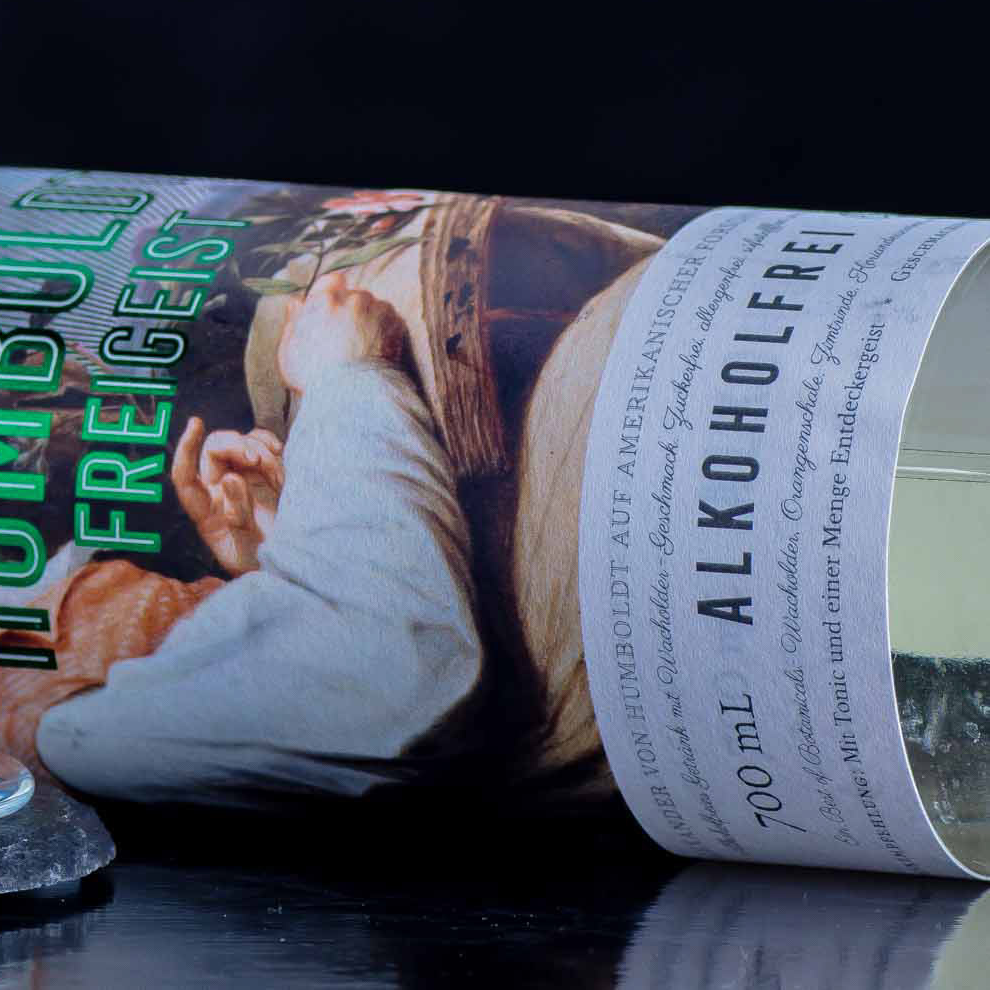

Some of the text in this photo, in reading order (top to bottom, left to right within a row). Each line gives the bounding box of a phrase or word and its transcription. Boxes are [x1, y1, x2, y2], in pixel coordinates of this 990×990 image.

[74, 209, 249, 553] FREIGEIST
[617, 253, 707, 478] AMERIKANISCHER
[830, 322, 886, 467] Entdeckergeist
[696, 230, 855, 626] ALKOHOLFREI
[611, 489, 632, 549] AUF
[822, 473, 851, 548] Menge
[777, 531, 803, 654] Wacholder,
[821, 554, 842, 614] einer
[611, 559, 646, 723] HUMBOLDT
[822, 620, 843, 664] und
[666, 690, 684, 724] mit
[718, 693, 763, 755] mL
[828, 669, 853, 727] Tonic
[631, 730, 659, 778] VON
[802, 766, 833, 785] of
[837, 734, 861, 763] Mit
[736, 765, 807, 833] 700
[817, 788, 845, 824] Best
